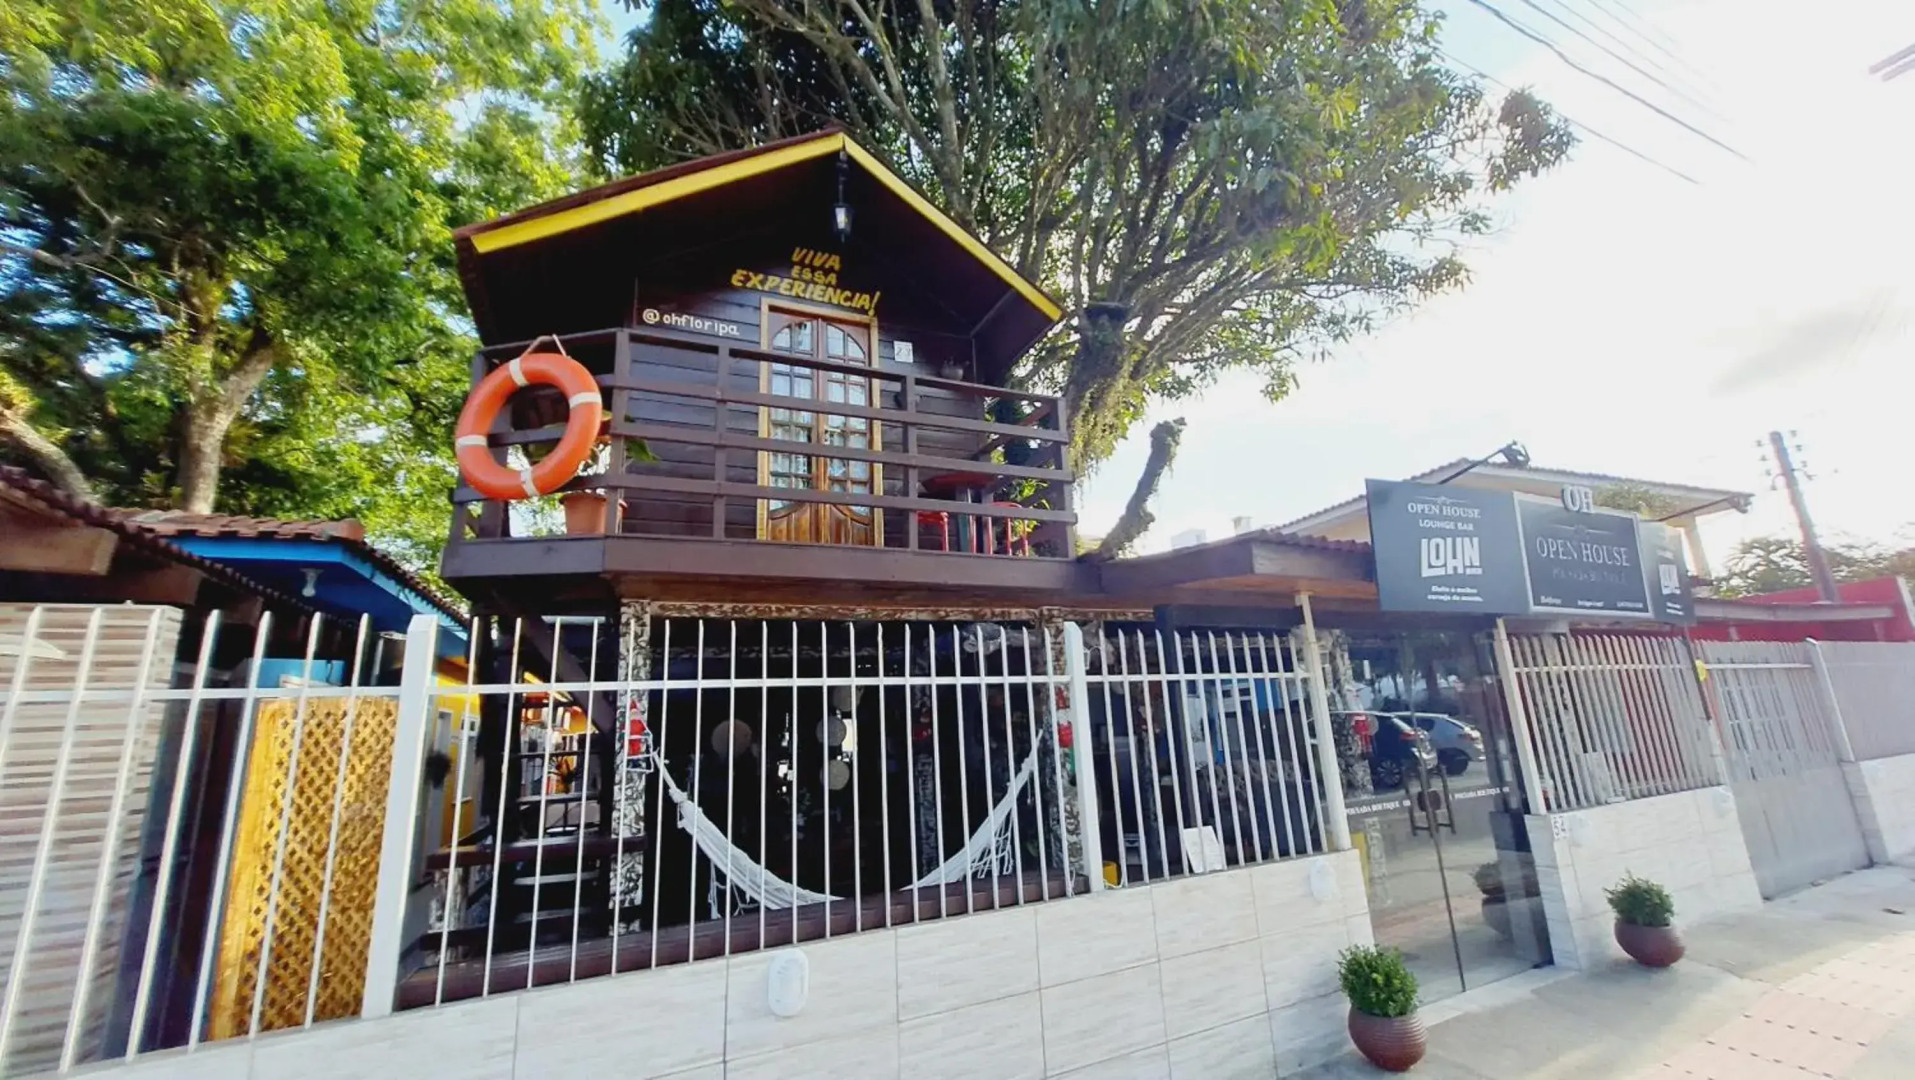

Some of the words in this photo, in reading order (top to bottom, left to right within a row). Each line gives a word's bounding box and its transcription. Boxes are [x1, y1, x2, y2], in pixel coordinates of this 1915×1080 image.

[791, 247, 841, 270] VIVA
[791, 265, 837, 285] ESSA
[1407, 502, 1440, 515] OPEN
[1442, 505, 1481, 519] HOUSE
[1561, 484, 1594, 514] OH
[1419, 519, 1456, 530] LOUNGE
[1457, 522, 1474, 531] BAR
[1420, 537, 1483, 578] LOHN
[1536, 536, 1579, 561] OPEN
[1580, 542, 1631, 567] HOUSE
